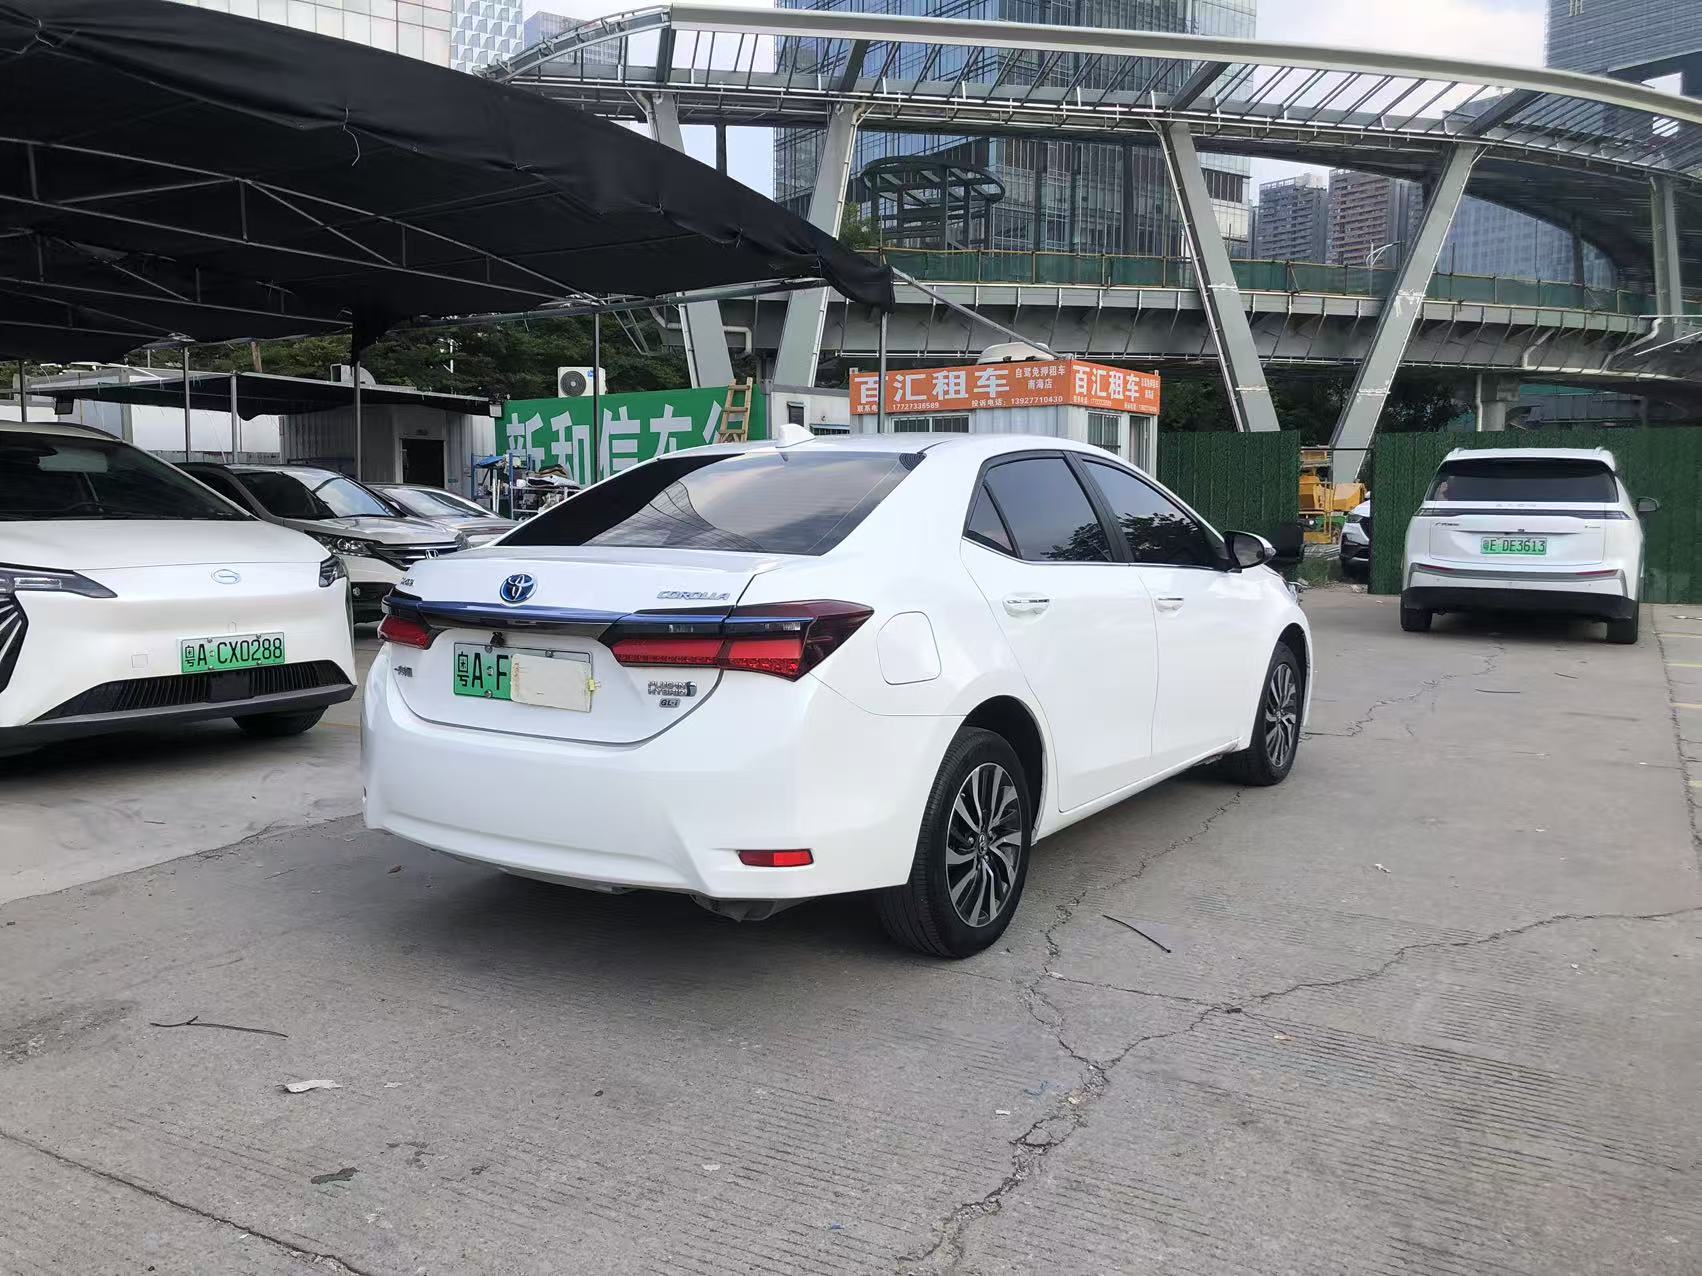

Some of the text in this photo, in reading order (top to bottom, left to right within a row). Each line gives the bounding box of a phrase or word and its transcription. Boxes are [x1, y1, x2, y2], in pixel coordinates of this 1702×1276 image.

[855, 367, 1009, 402] 百汇租车
[1072, 365, 1140, 402] 百汇租车
[1011, 396, 1063, 405] 13927710430
[656, 591, 731, 600] COROLLA
[217, 637, 283, 664] CX0288
